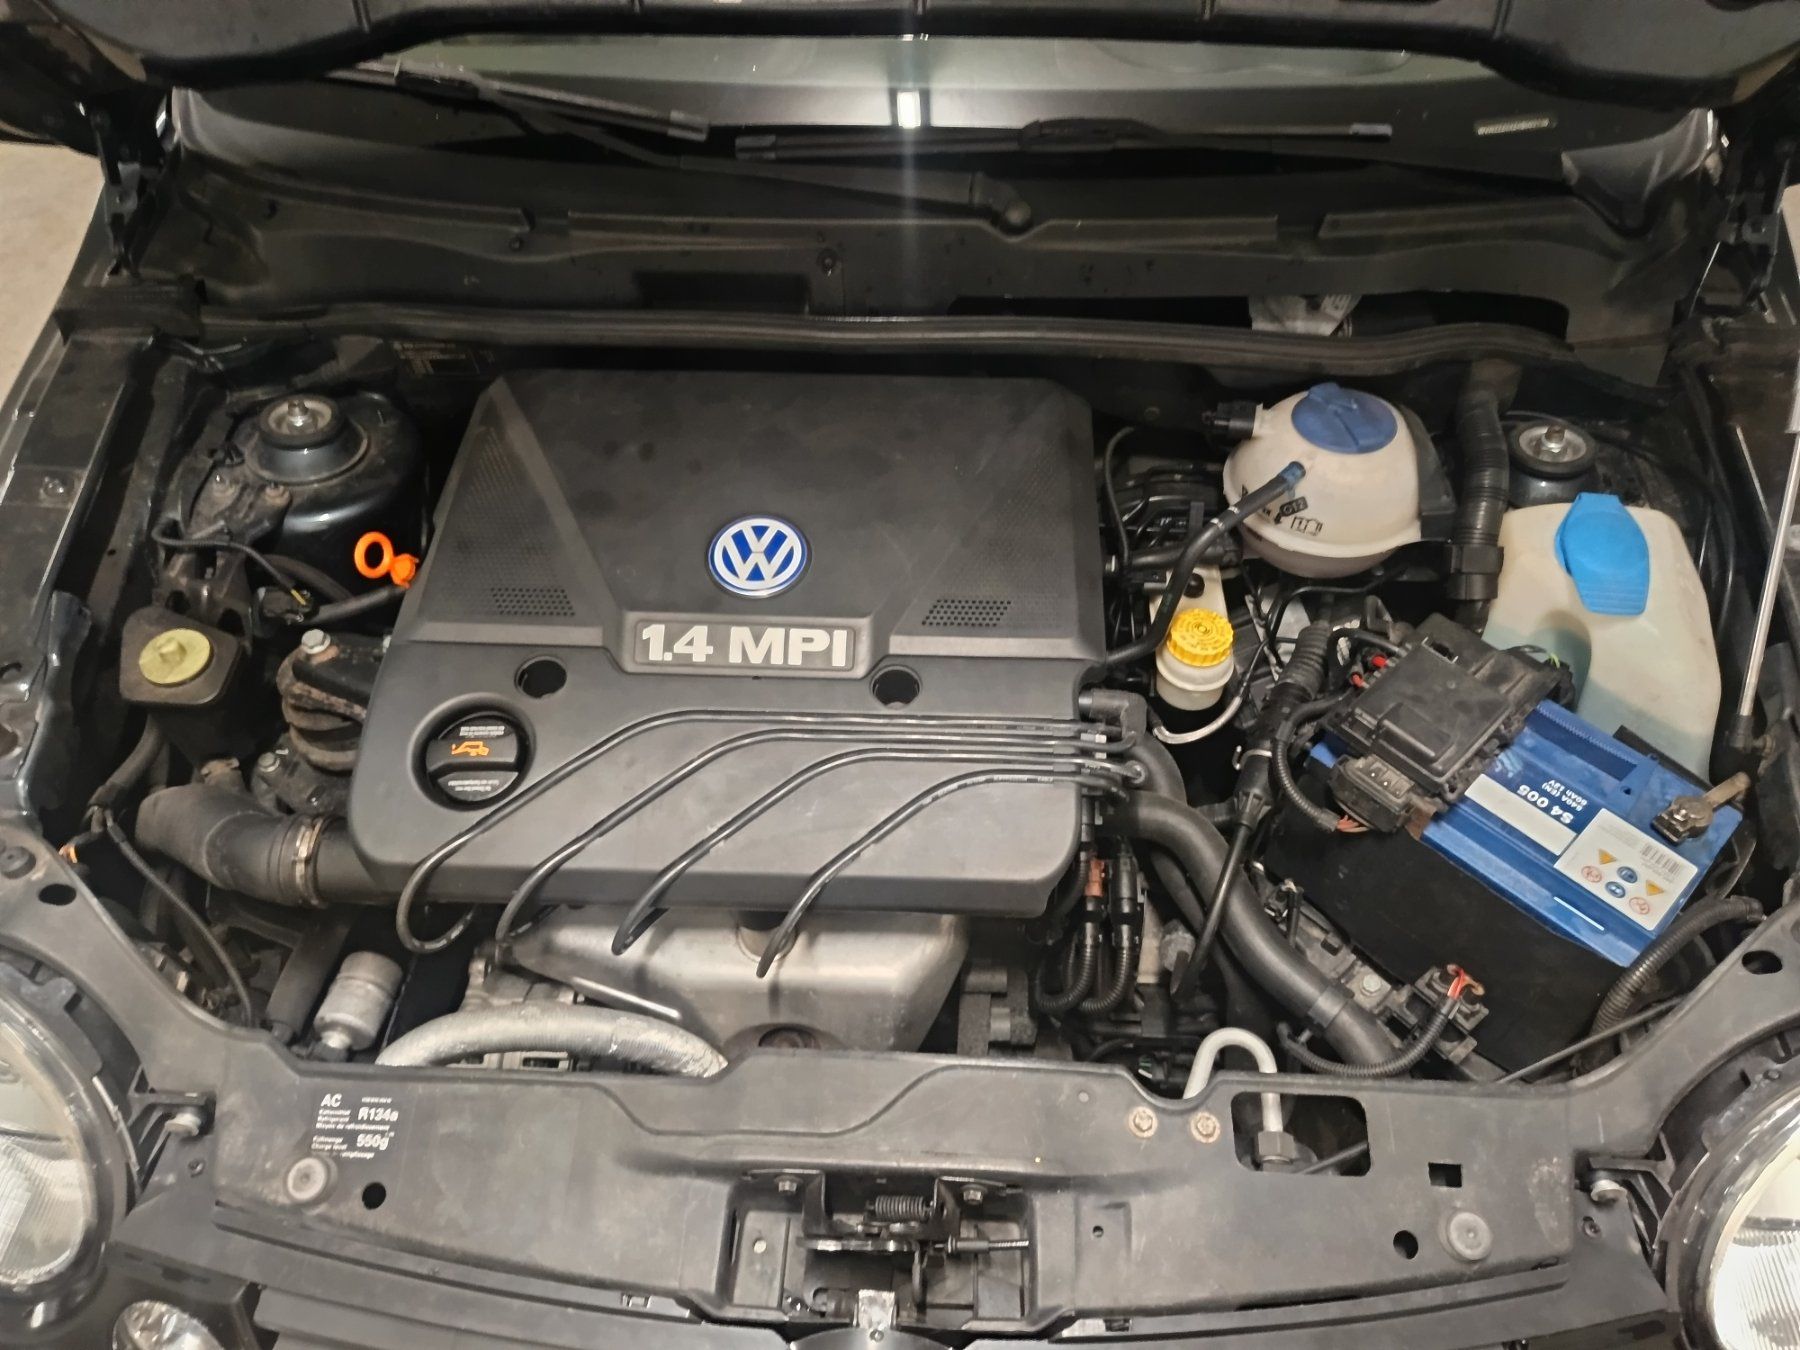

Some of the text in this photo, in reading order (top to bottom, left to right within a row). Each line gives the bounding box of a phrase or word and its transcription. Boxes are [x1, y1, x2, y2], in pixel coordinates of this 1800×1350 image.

[641, 623, 848, 667] 1.4 MPI
[1517, 784, 1574, 824] S4 005
[320, 1093, 343, 1107] AC
[357, 1106, 399, 1121] R134a
[356, 1133, 390, 1150] 550g
